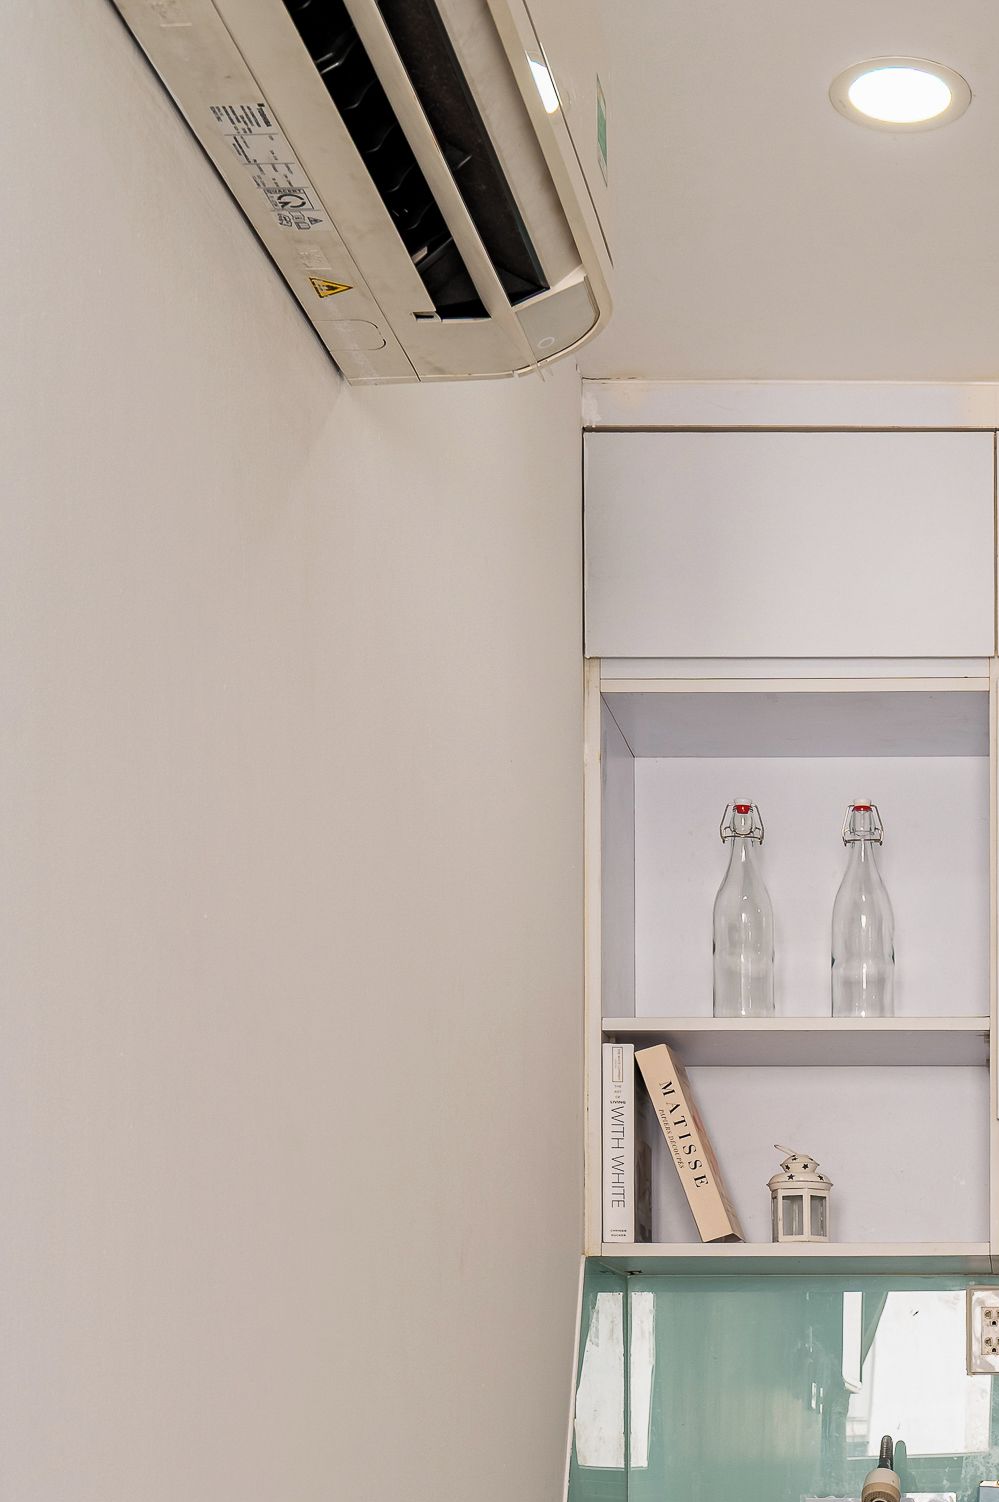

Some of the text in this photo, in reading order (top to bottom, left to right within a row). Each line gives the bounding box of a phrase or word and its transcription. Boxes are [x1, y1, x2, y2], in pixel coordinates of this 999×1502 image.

[611, 1106, 625, 1208] WITH WHITE
[659, 1080, 708, 1188] MATISSE
